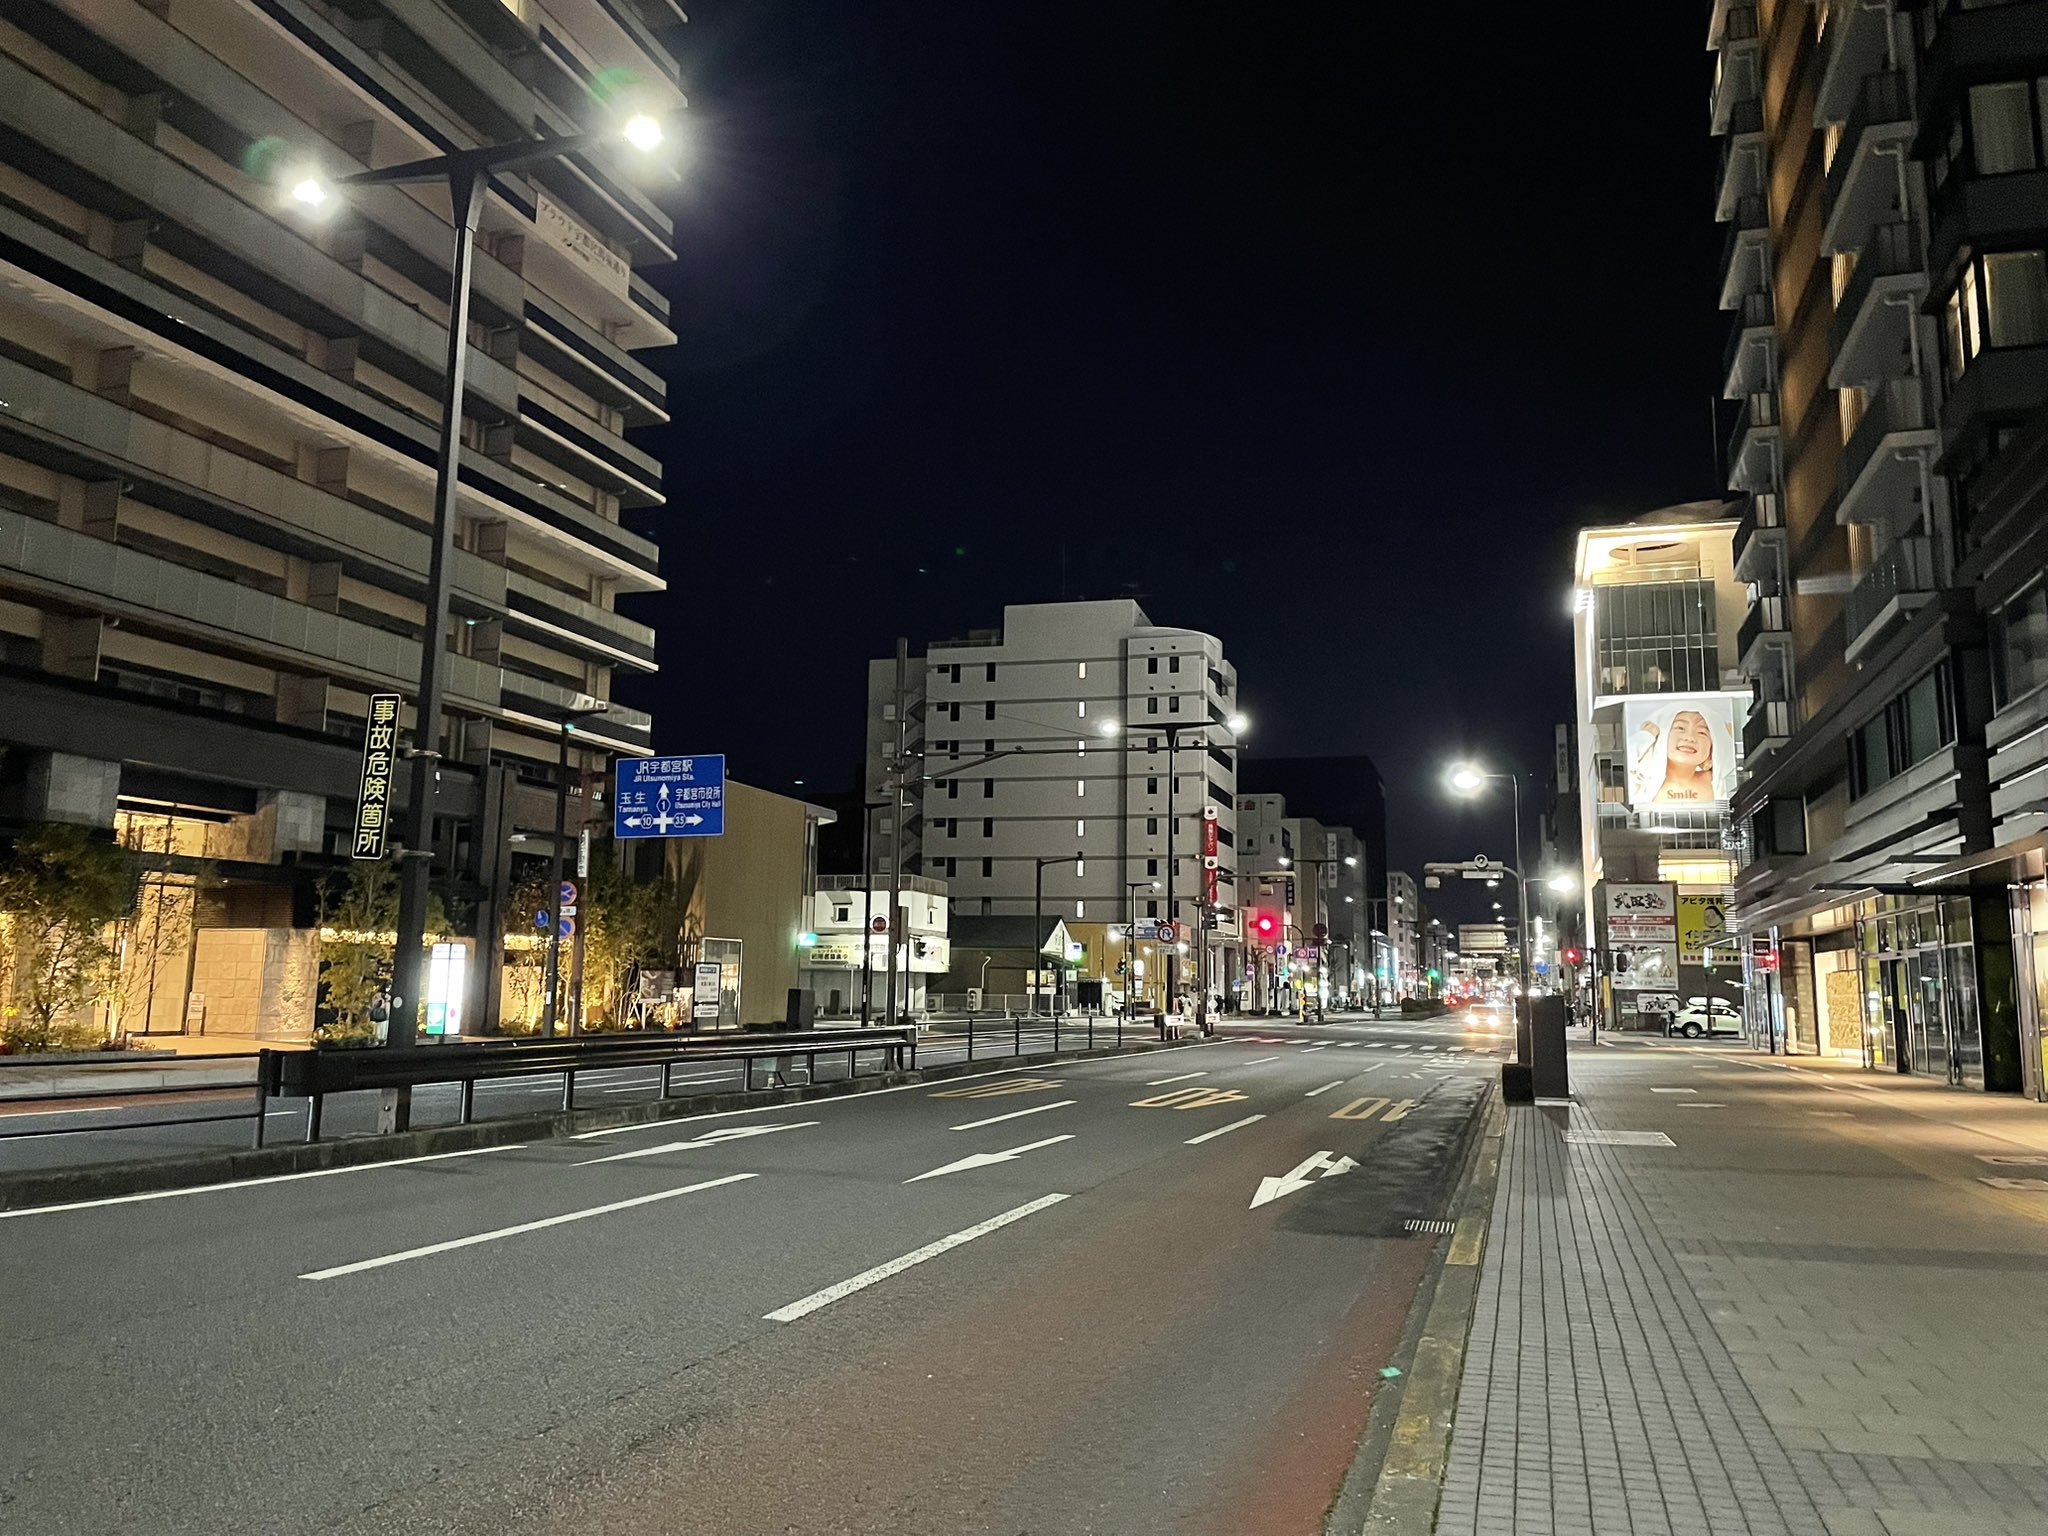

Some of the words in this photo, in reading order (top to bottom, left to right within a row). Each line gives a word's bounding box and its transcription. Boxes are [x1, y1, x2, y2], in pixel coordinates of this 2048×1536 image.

[636, 759, 693, 775] JR宇都宮駅
[356, 699, 396, 854] 事故危険箇所
[643, 774, 681, 783] Utsunomiya
[675, 786, 721, 801] 宇都宮市役所
[1667, 789, 1698, 800] Smile
[618, 805, 648, 814] Tamanyu
[660, 801, 666, 810] 1
[642, 817, 651, 826] 10
[675, 816, 684, 825] 35
[1128, 1087, 1249, 1110] 40
[1328, 1097, 1416, 1122] 40
